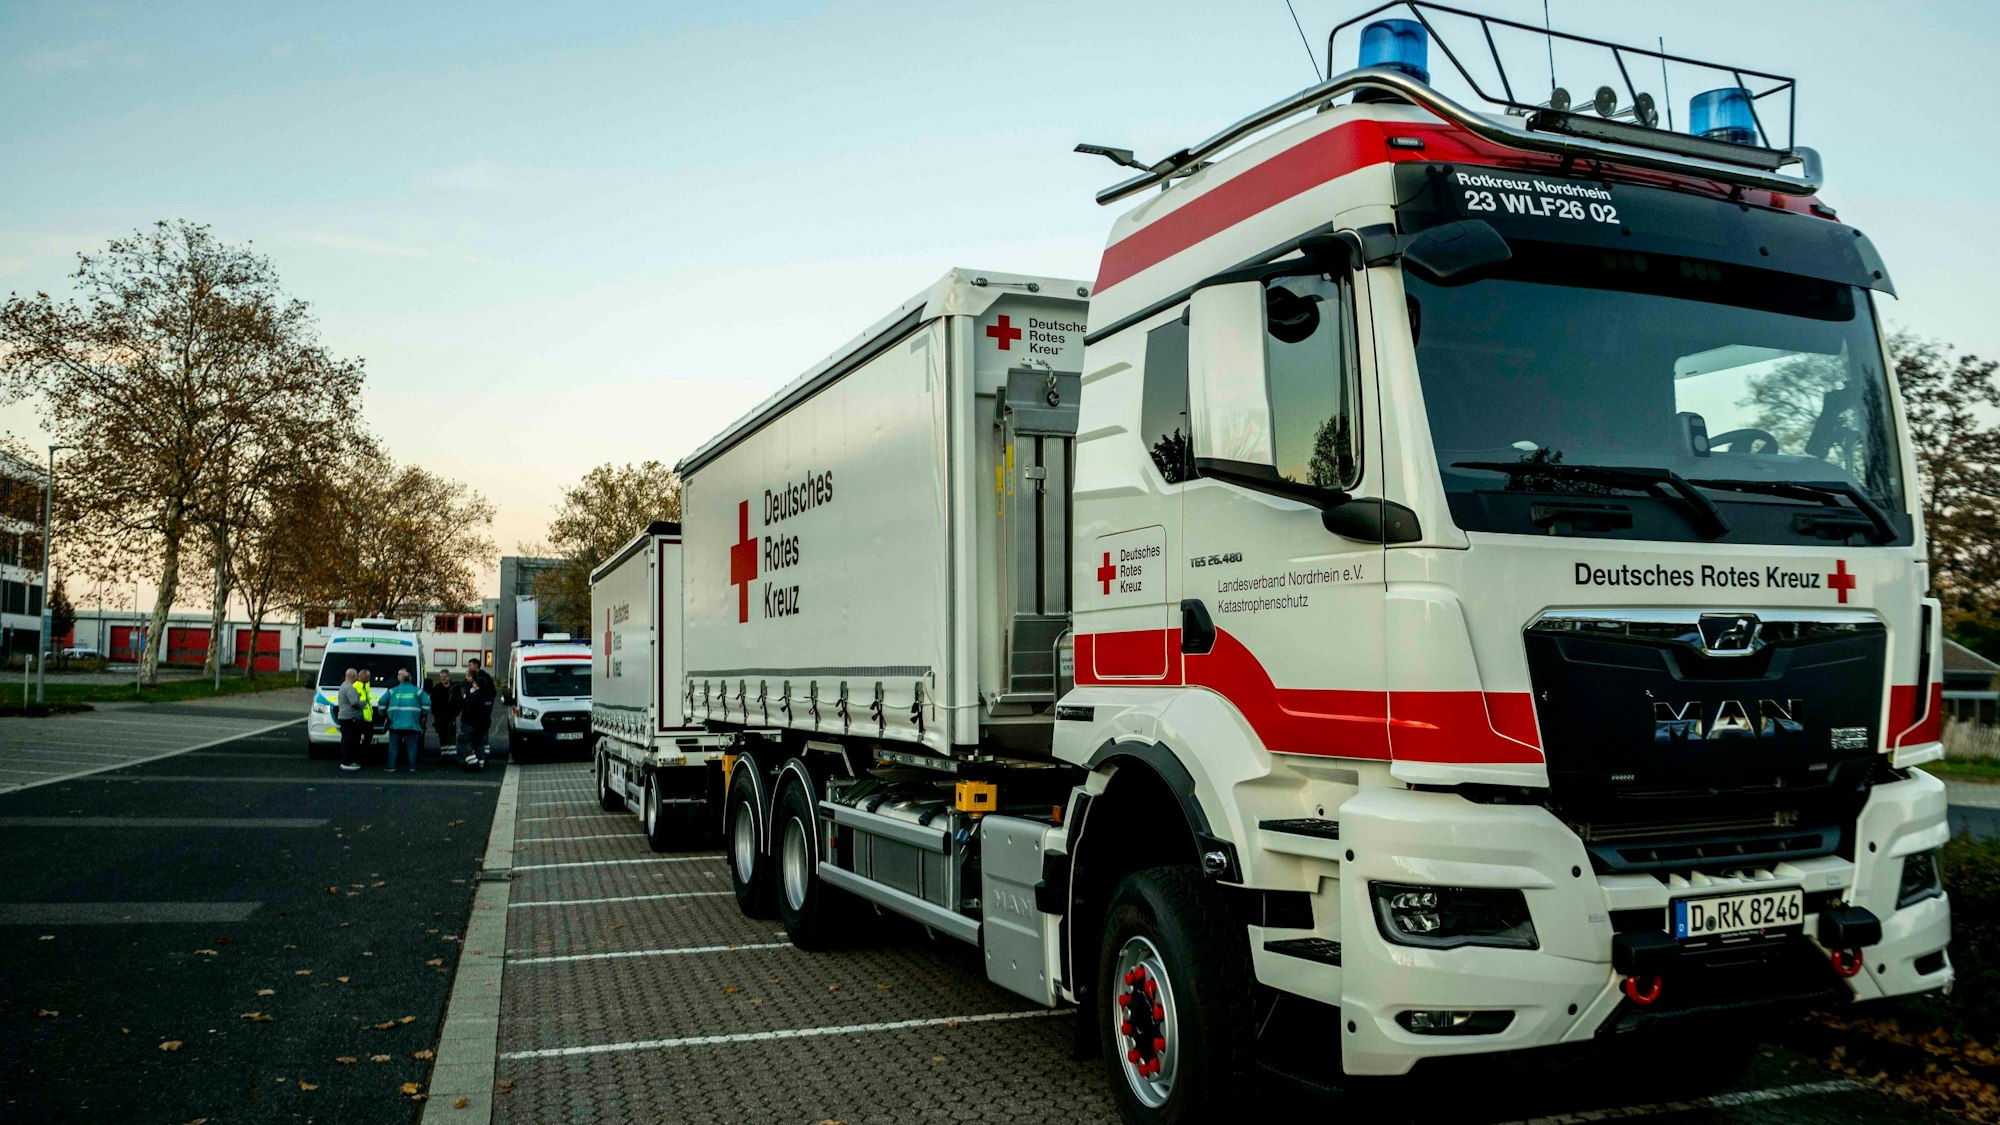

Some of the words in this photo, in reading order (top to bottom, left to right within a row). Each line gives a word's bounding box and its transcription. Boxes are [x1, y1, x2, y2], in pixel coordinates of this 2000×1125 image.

[1456, 172, 1532, 192] Rotkreuz
[1533, 180, 1612, 200] Nordrhein
[1464, 190, 1497, 212] 23
[1499, 192, 1586, 220] WLF26
[1589, 202, 1621, 225] 02
[1029, 318, 1087, 333] Deutsche
[1029, 330, 1066, 344] Rotes
[1030, 342, 1064, 355] Kreu
[765, 470, 833, 526] Deutsches
[765, 533, 799, 572] Rotes
[1120, 544, 1161, 562] Deutsches
[1190, 556, 1206, 568] TGS
[1208, 552, 1243, 566] 26.480
[1120, 564, 1142, 577] Rotes
[1217, 573, 1286, 594] Landesverband
[1288, 567, 1340, 587] Nordrhein
[1343, 564, 1364, 582] e.V.
[1574, 562, 1695, 587] Deutsches
[1701, 564, 1760, 588] Rotes
[1766, 566, 1821, 589] Kreuz
[1120, 580, 1142, 593] Kreuz
[765, 582, 800, 619] Kreuz
[1217, 593, 1309, 614] Katastrophenschutz
[1653, 698, 1804, 742] MAN
[1691, 904, 1704, 932] D
[1718, 899, 1745, 929] RK
[1750, 894, 1800, 925] 8246
